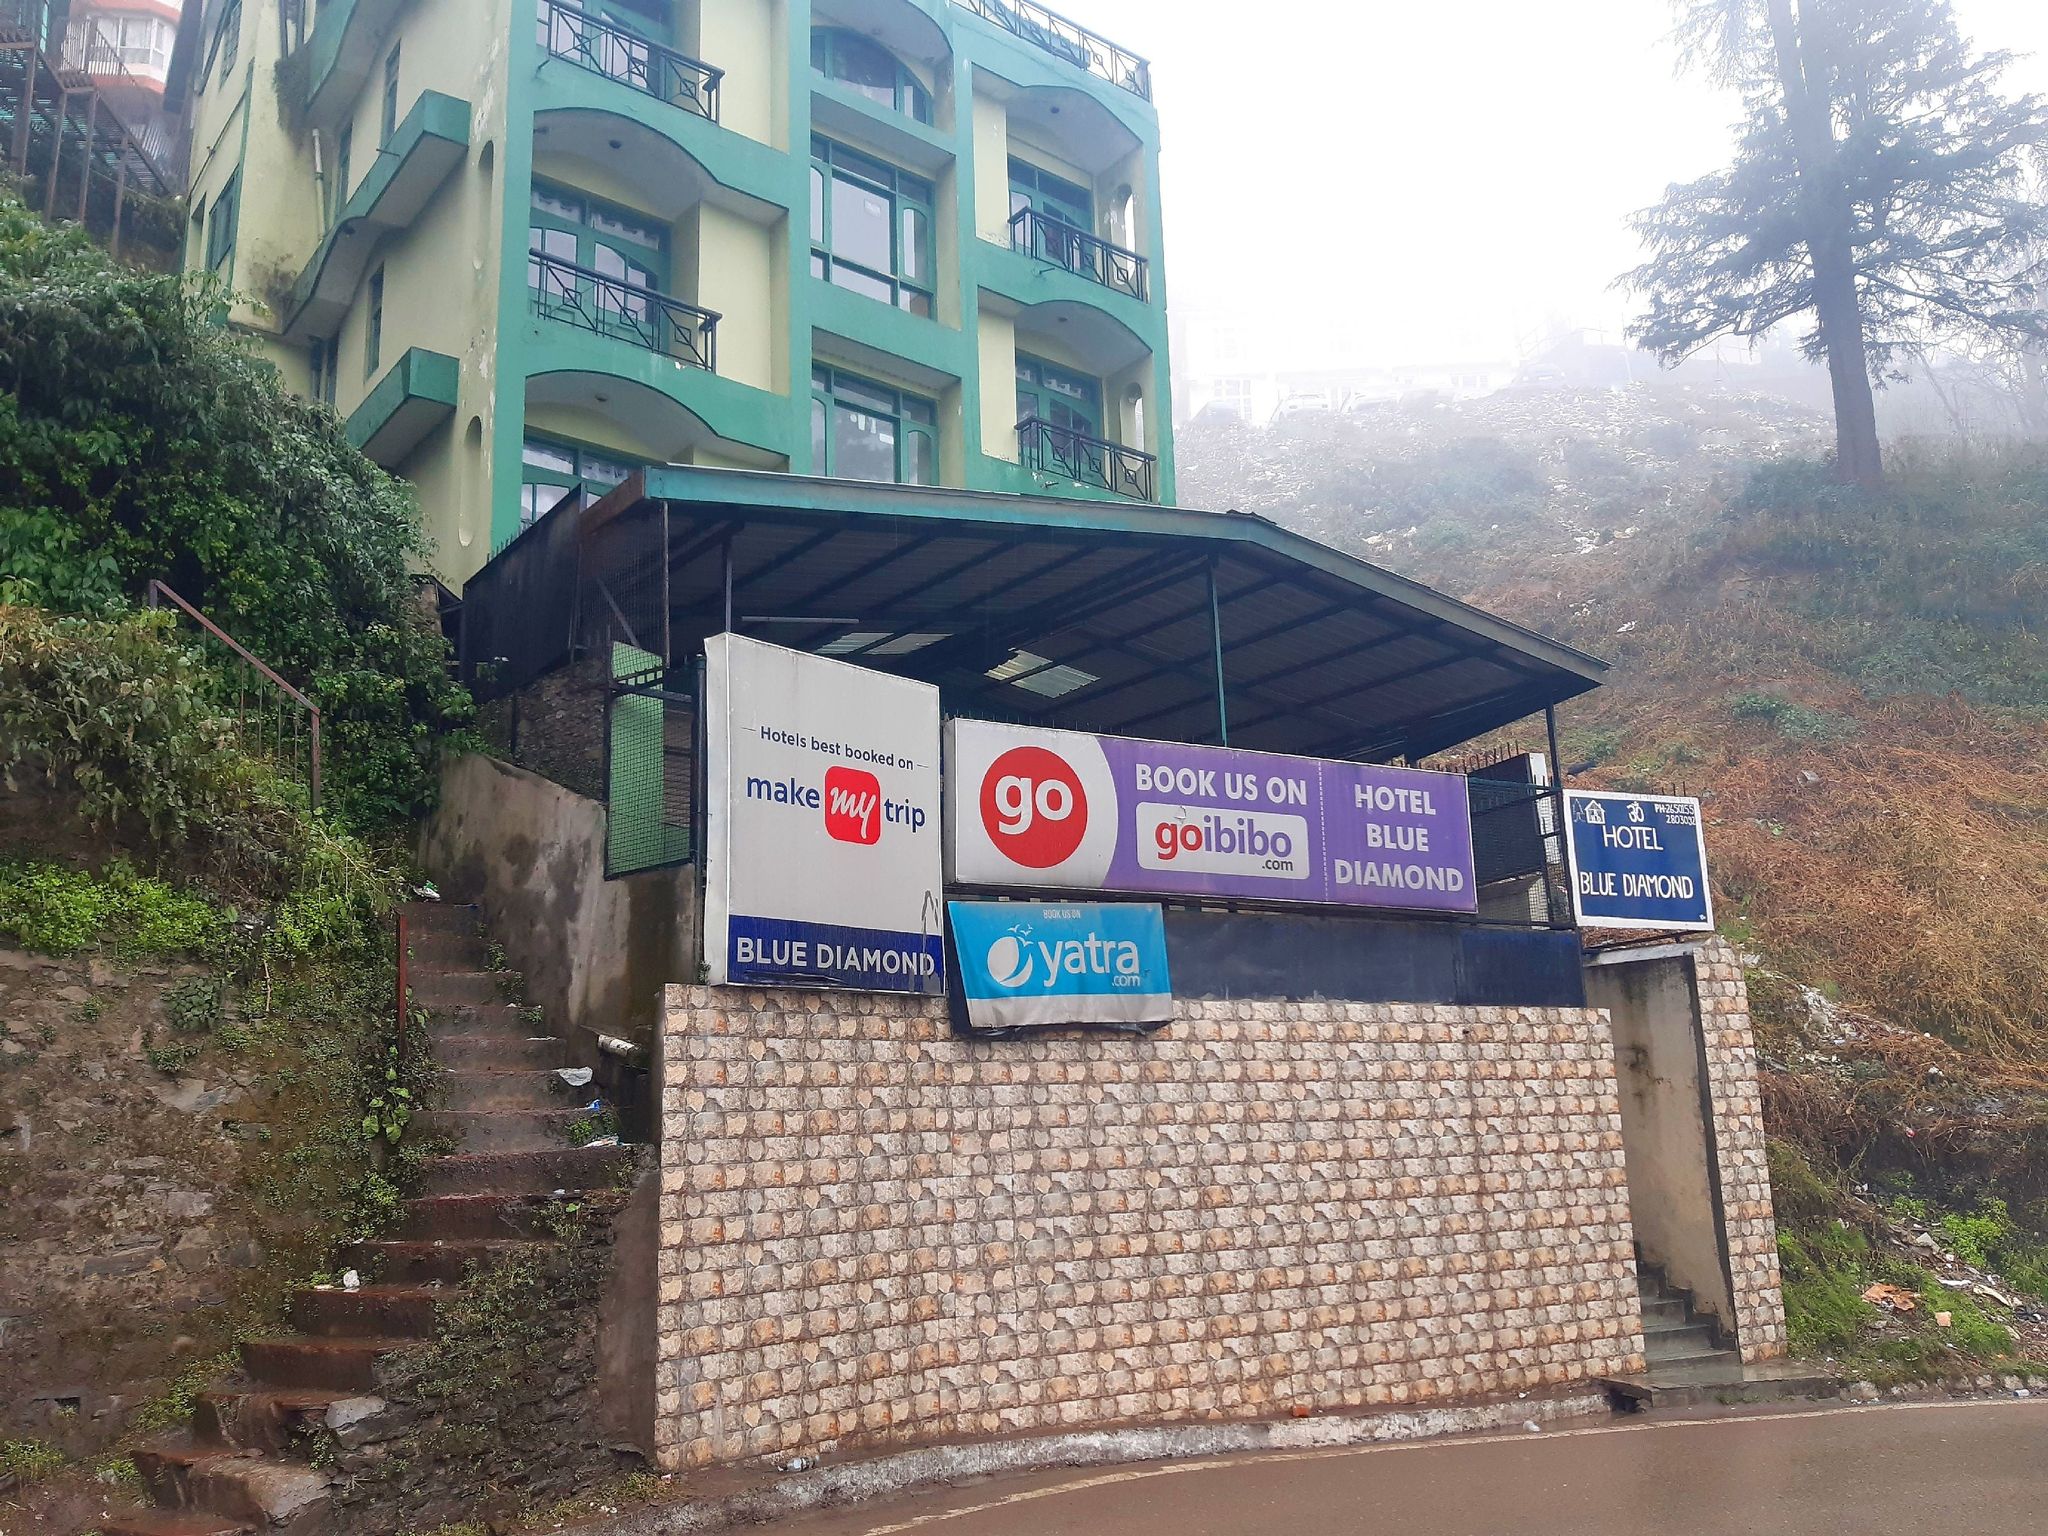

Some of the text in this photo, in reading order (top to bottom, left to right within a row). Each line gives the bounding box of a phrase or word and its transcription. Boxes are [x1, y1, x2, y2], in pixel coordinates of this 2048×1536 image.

[760, 725, 914, 771] Hotels best booked on
[1135, 763, 1307, 805] BOOK US ON
[1354, 783, 1437, 816] HOTEL
[747, 776, 926, 839] make my trip
[995, 775, 1073, 835] go
[1154, 814, 1292, 861] goibibo
[1366, 823, 1429, 852] BLUE
[1602, 825, 1664, 851] HOTEL
[1261, 859, 1293, 872] .com
[1334, 859, 1464, 892] DIAMOND
[1580, 872, 1694, 899] BLUE DIAMOND
[737, 937, 935, 976] BLUE DIAMOND
[1038, 932, 1140, 987] yatra
[1111, 975, 1140, 987] .com
